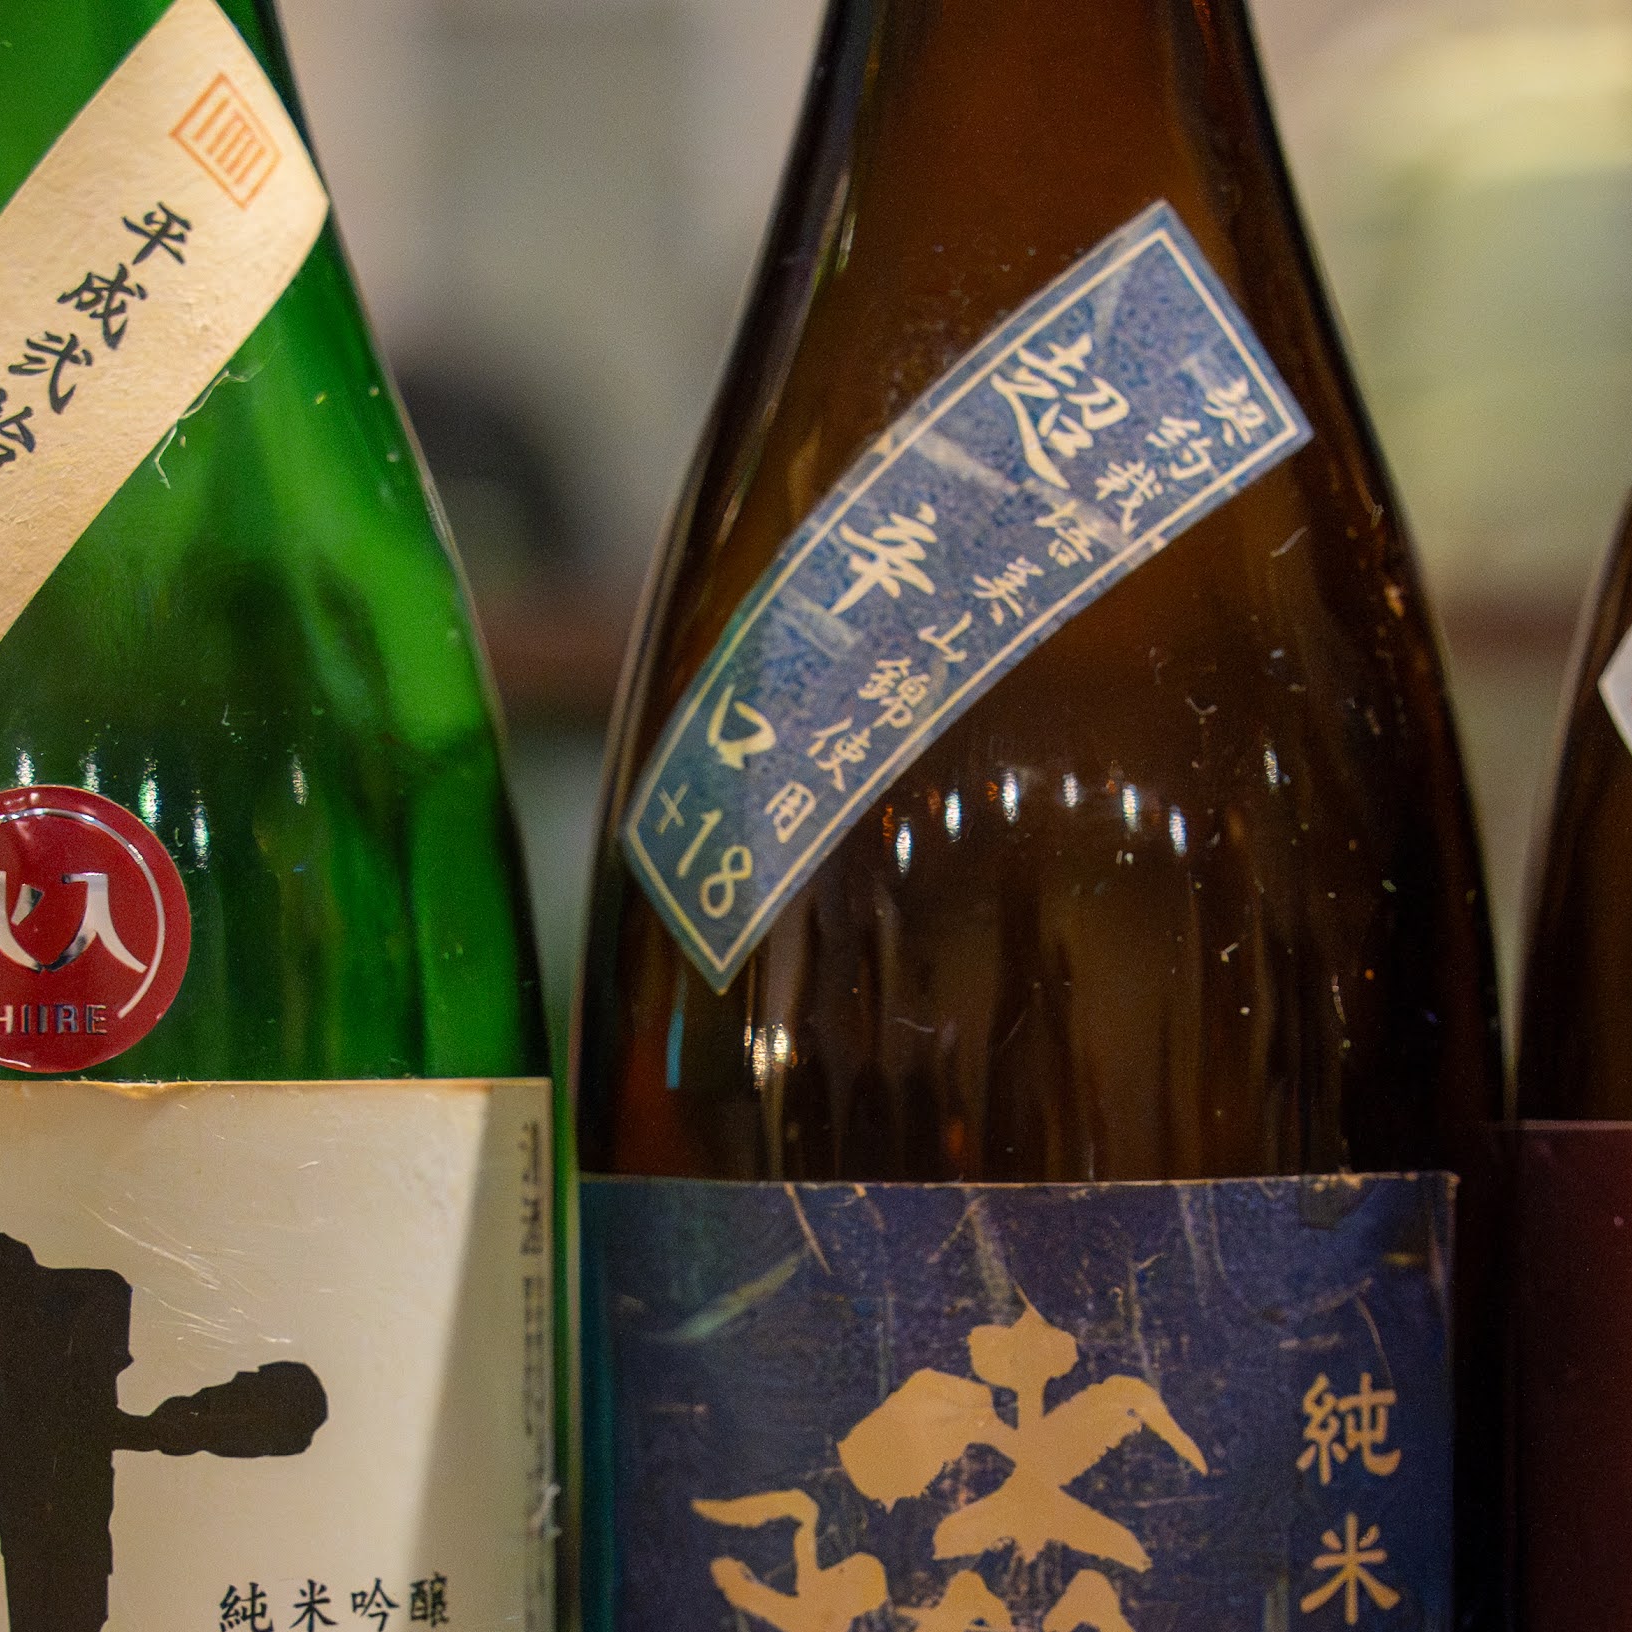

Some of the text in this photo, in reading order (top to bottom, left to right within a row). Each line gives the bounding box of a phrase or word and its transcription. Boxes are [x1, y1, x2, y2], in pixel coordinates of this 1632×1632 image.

[658, 333, 1129, 920] 超辛口 +18
